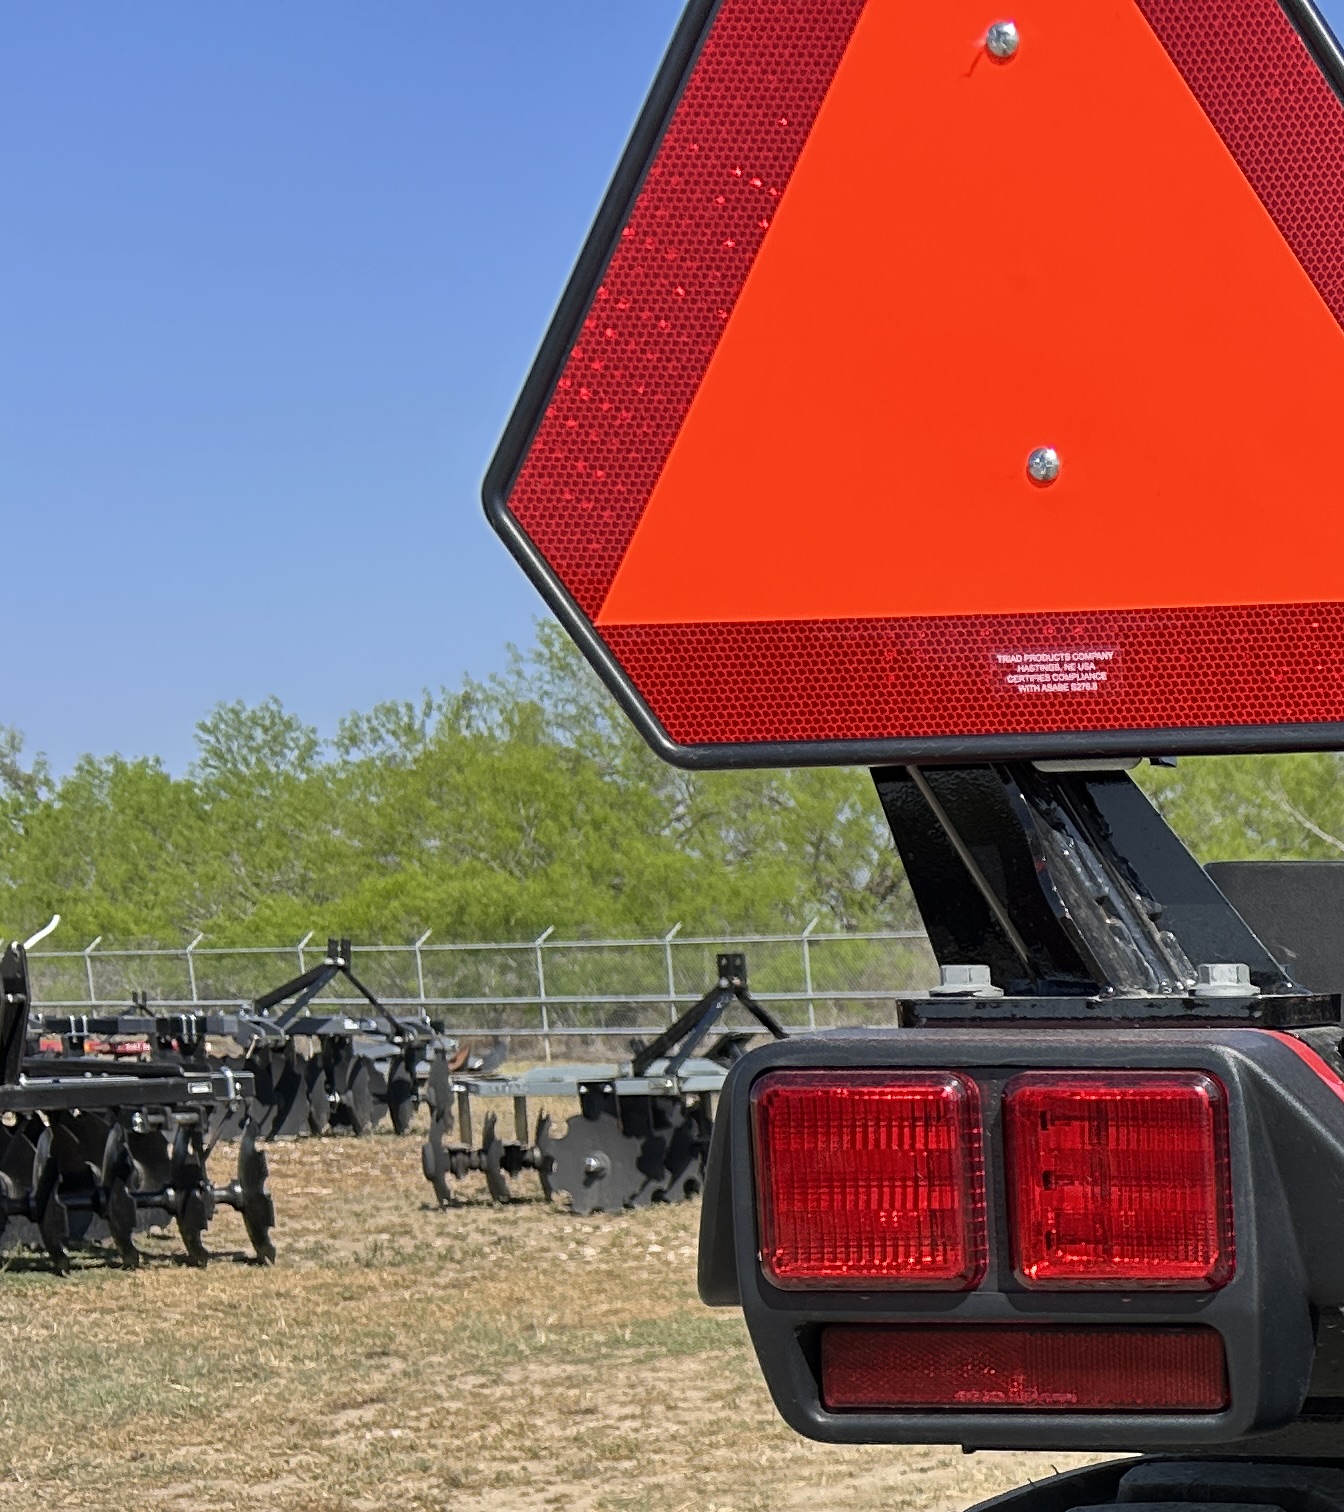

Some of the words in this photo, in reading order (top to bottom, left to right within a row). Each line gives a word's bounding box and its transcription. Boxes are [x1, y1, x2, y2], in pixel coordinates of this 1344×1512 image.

[997, 654, 1022, 663] TRIAD
[1024, 653, 1071, 662] PRODUCTS
[1072, 651, 1114, 661] COMPANY
[1077, 662, 1096, 671] USA
[1052, 672, 1108, 682] COMPLIANCE
[1018, 684, 1041, 692] WITH
